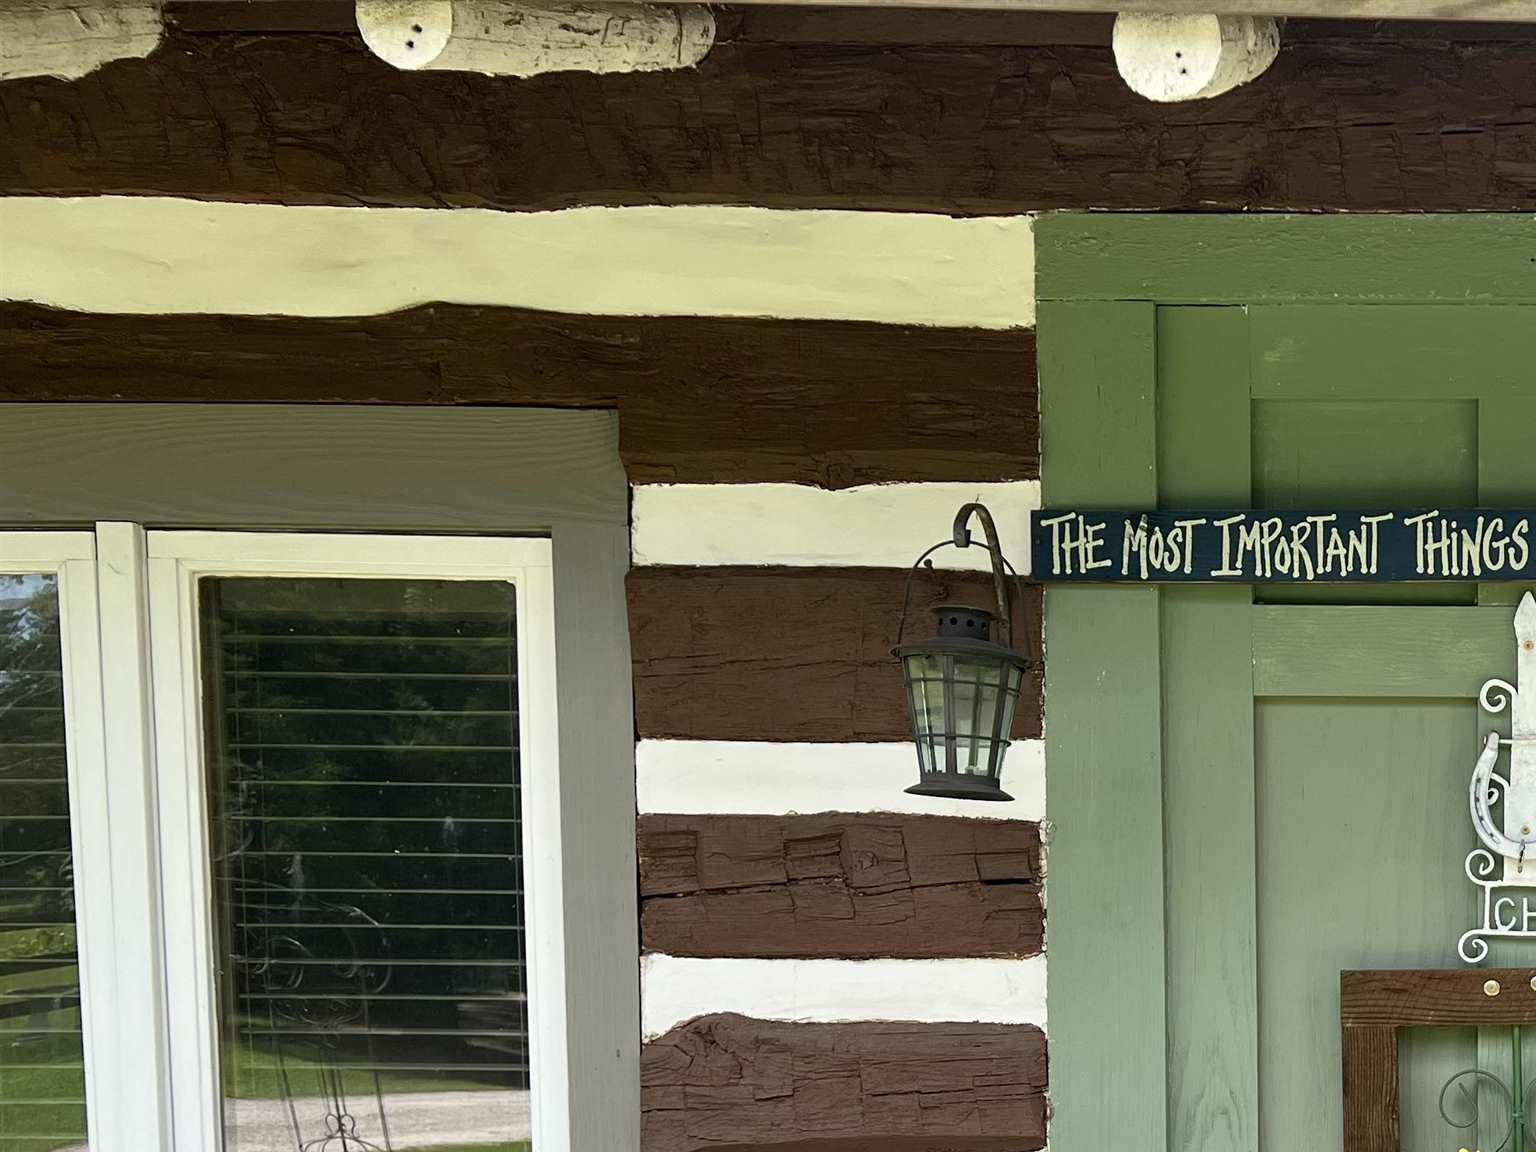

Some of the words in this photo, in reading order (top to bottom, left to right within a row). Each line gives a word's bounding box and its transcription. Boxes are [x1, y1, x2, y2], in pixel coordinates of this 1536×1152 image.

[1040, 512, 1112, 575] THE
[1122, 513, 1207, 579] MOST
[1210, 514, 1394, 580] IMPORTANT
